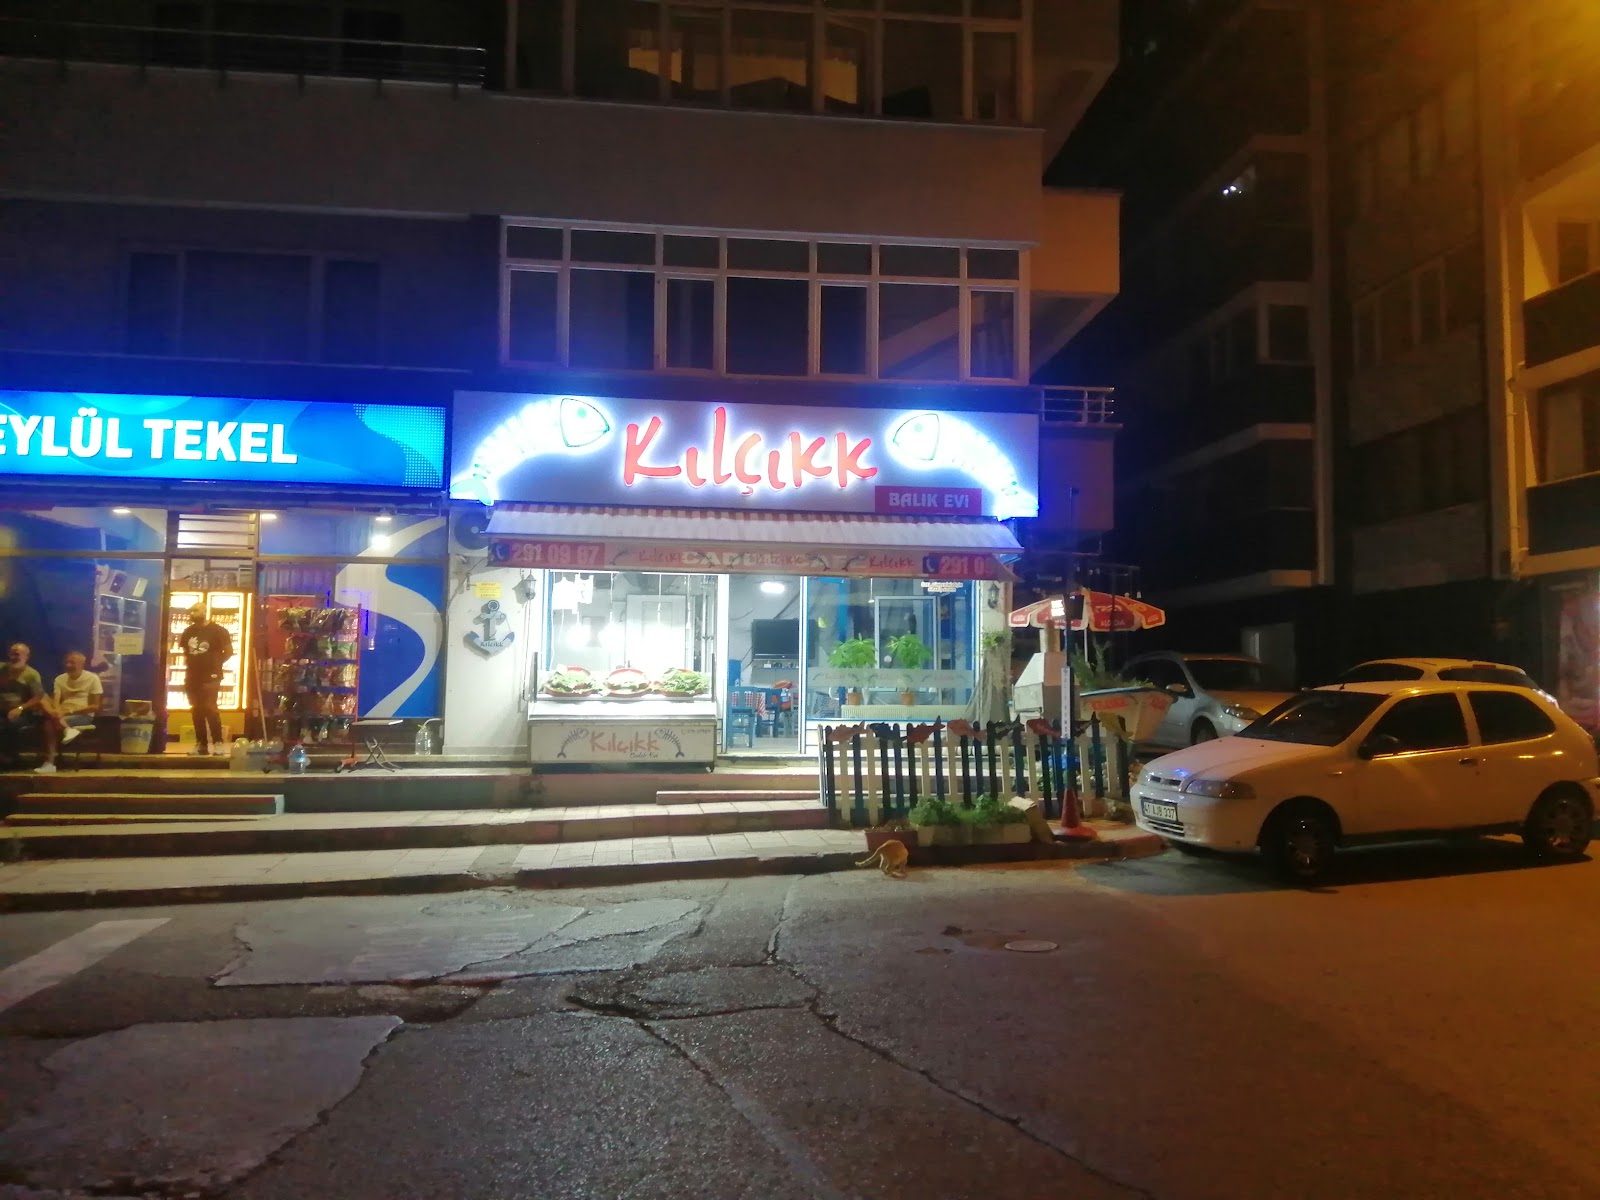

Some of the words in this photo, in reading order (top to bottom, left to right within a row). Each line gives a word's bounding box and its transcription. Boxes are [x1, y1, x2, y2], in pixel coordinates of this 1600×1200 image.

[0, 407, 133, 458] YLÜL
[143, 418, 298, 464] TEKEL
[624, 406, 878, 495] Kılçıkk
[889, 492, 938, 508] BALIK
[547, 544, 572, 565] 09
[940, 556, 969, 575] 291
